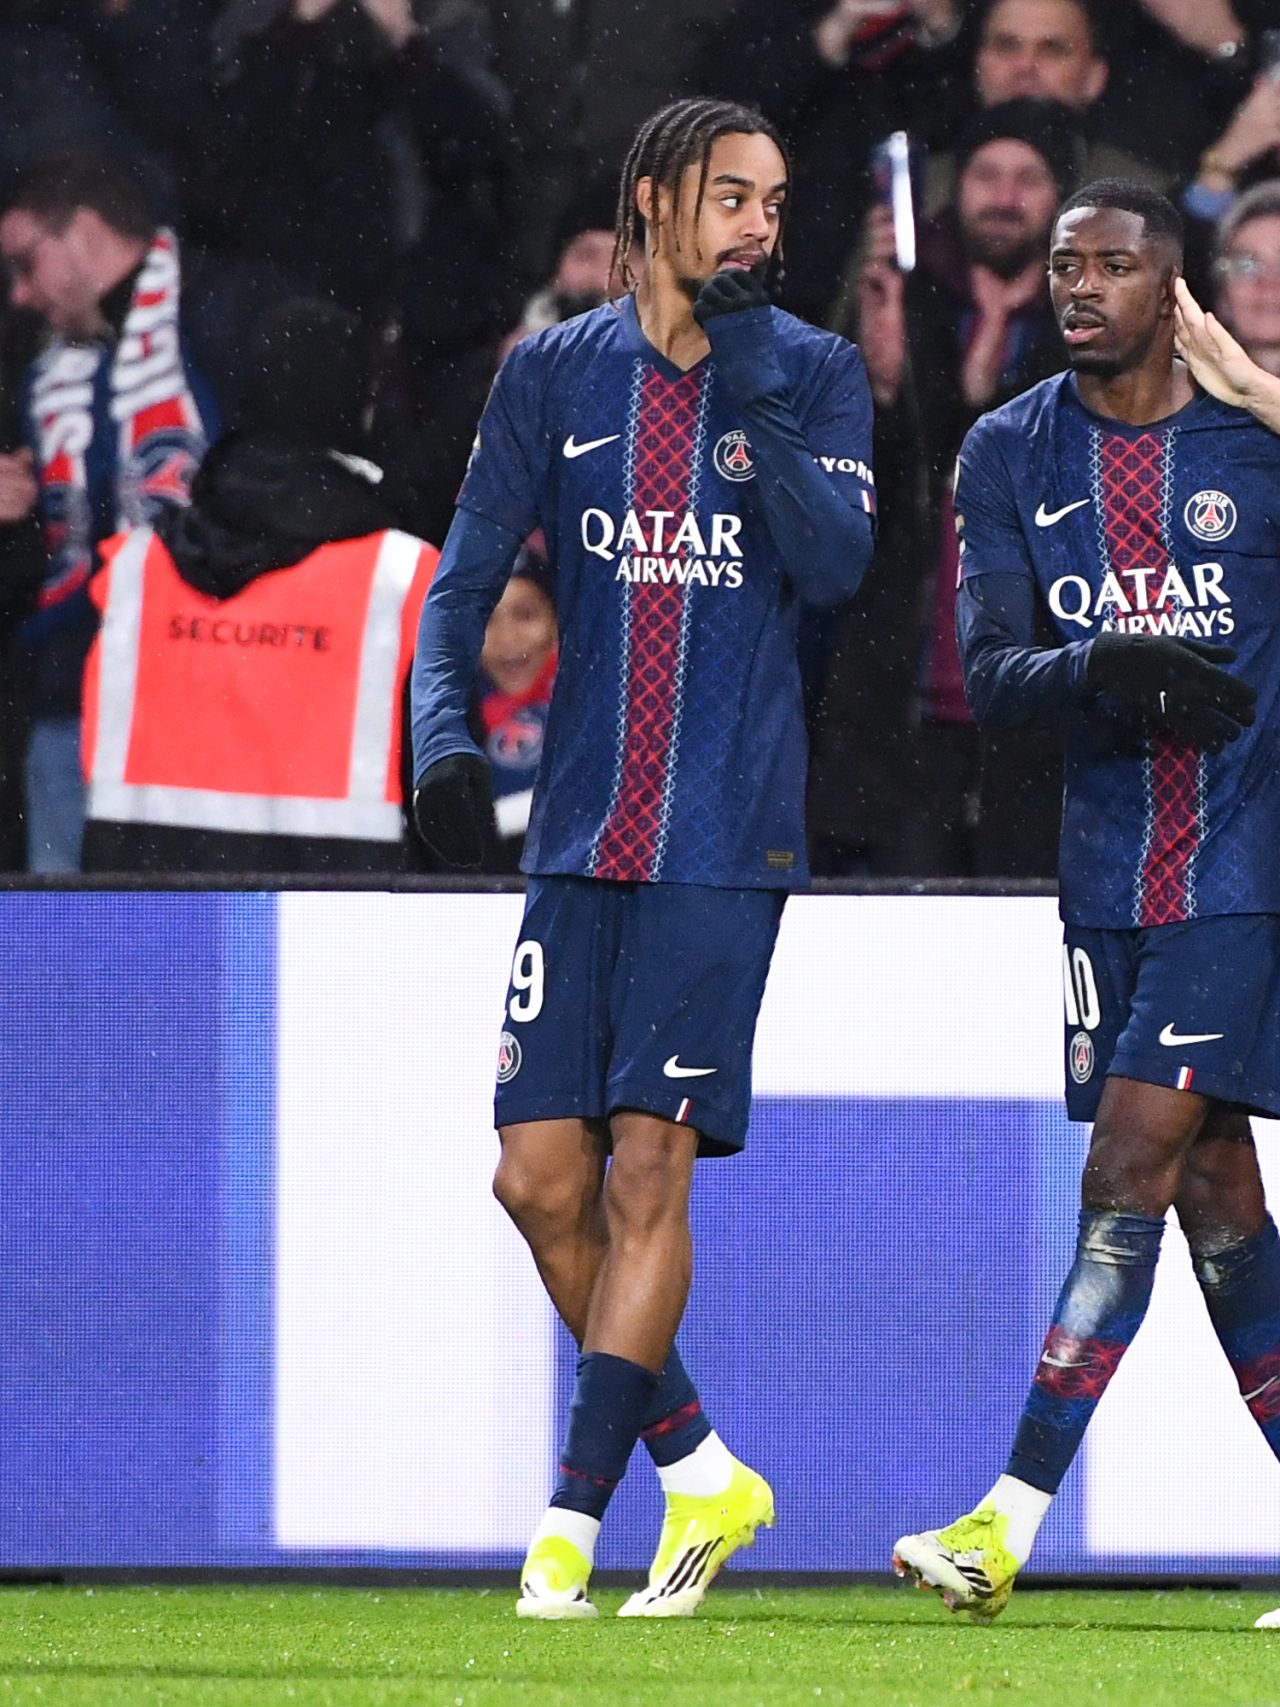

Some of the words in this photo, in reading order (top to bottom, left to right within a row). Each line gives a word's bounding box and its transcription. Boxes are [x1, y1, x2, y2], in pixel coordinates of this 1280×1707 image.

[581, 507, 744, 561] QATAR
[615, 557, 744, 589] AIRWAYS
[1048, 562, 1232, 628] QATAR
[1063, 943, 1101, 1031] 10
